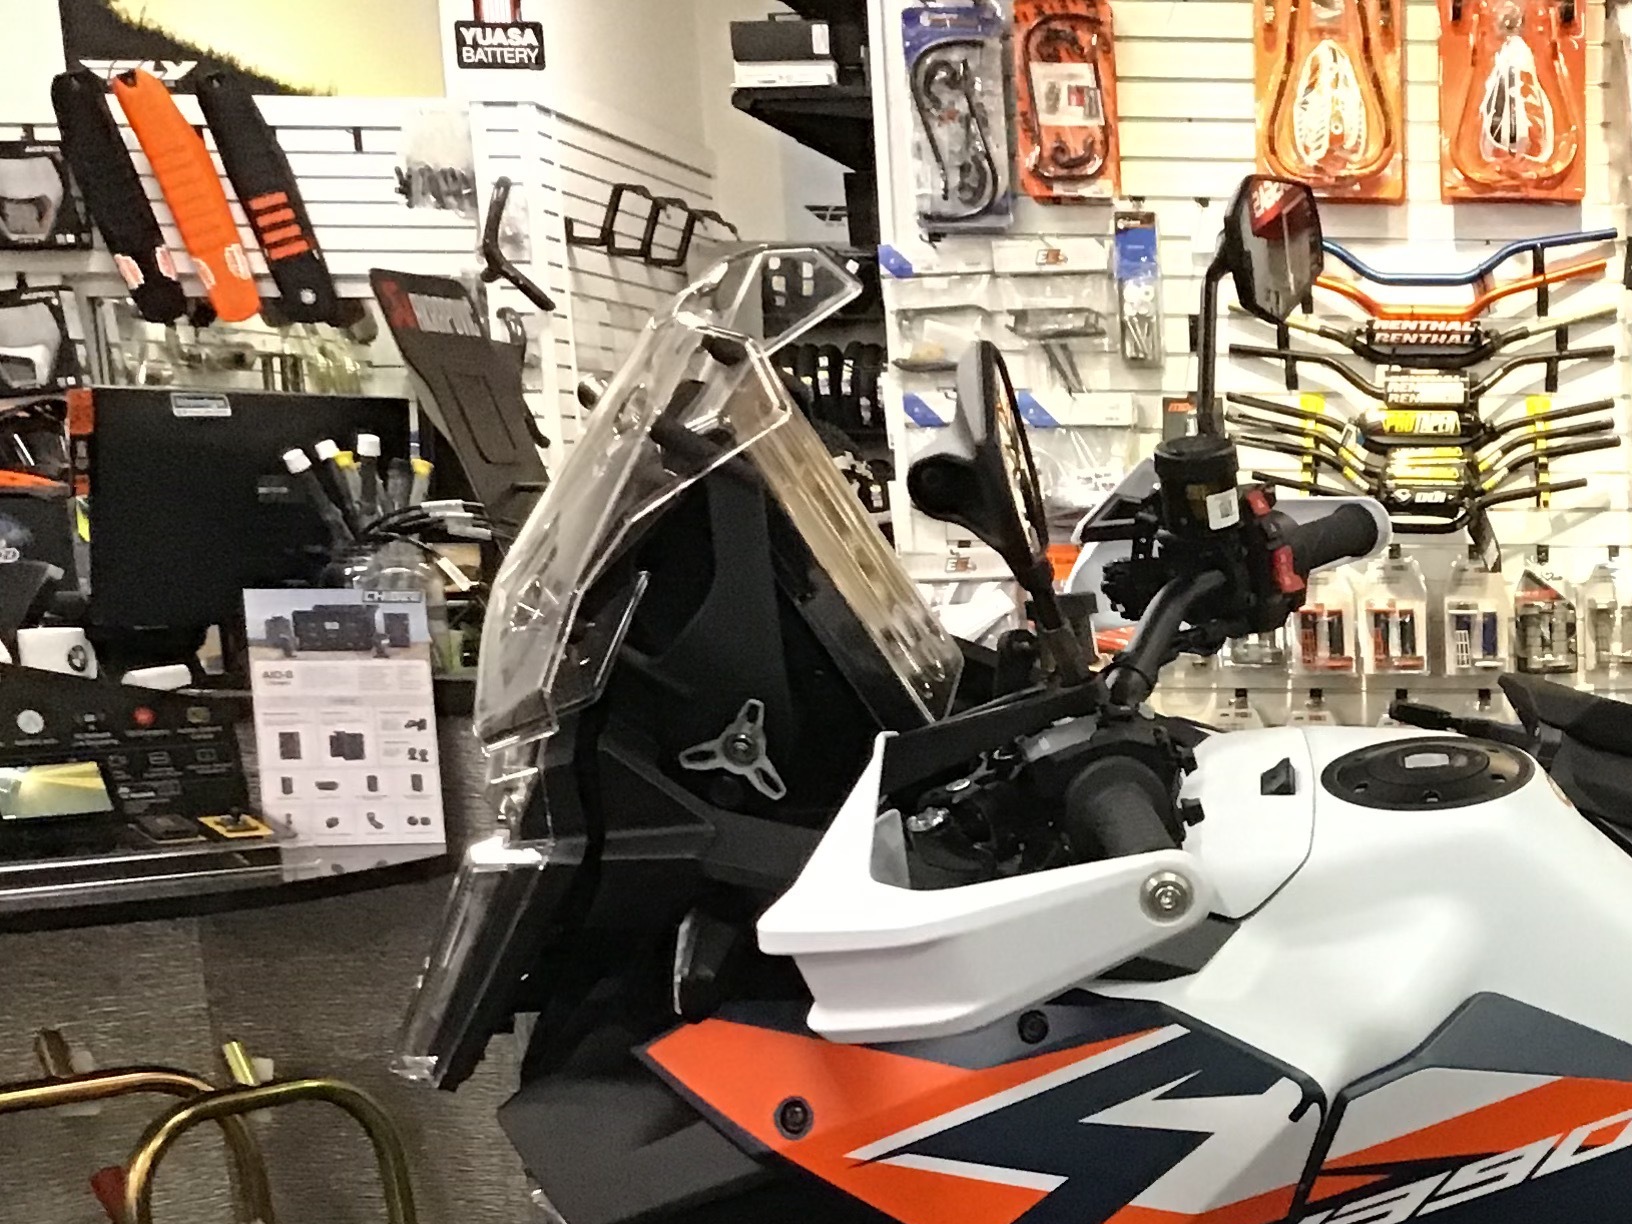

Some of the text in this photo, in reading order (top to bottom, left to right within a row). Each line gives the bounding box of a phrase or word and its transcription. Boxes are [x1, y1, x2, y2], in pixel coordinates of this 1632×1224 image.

[460, 27, 539, 46] YUASA
[462, 46, 539, 63] BATTERY
[1373, 320, 1476, 332] RENTHAL
[1374, 333, 1473, 344] RENTHAL
